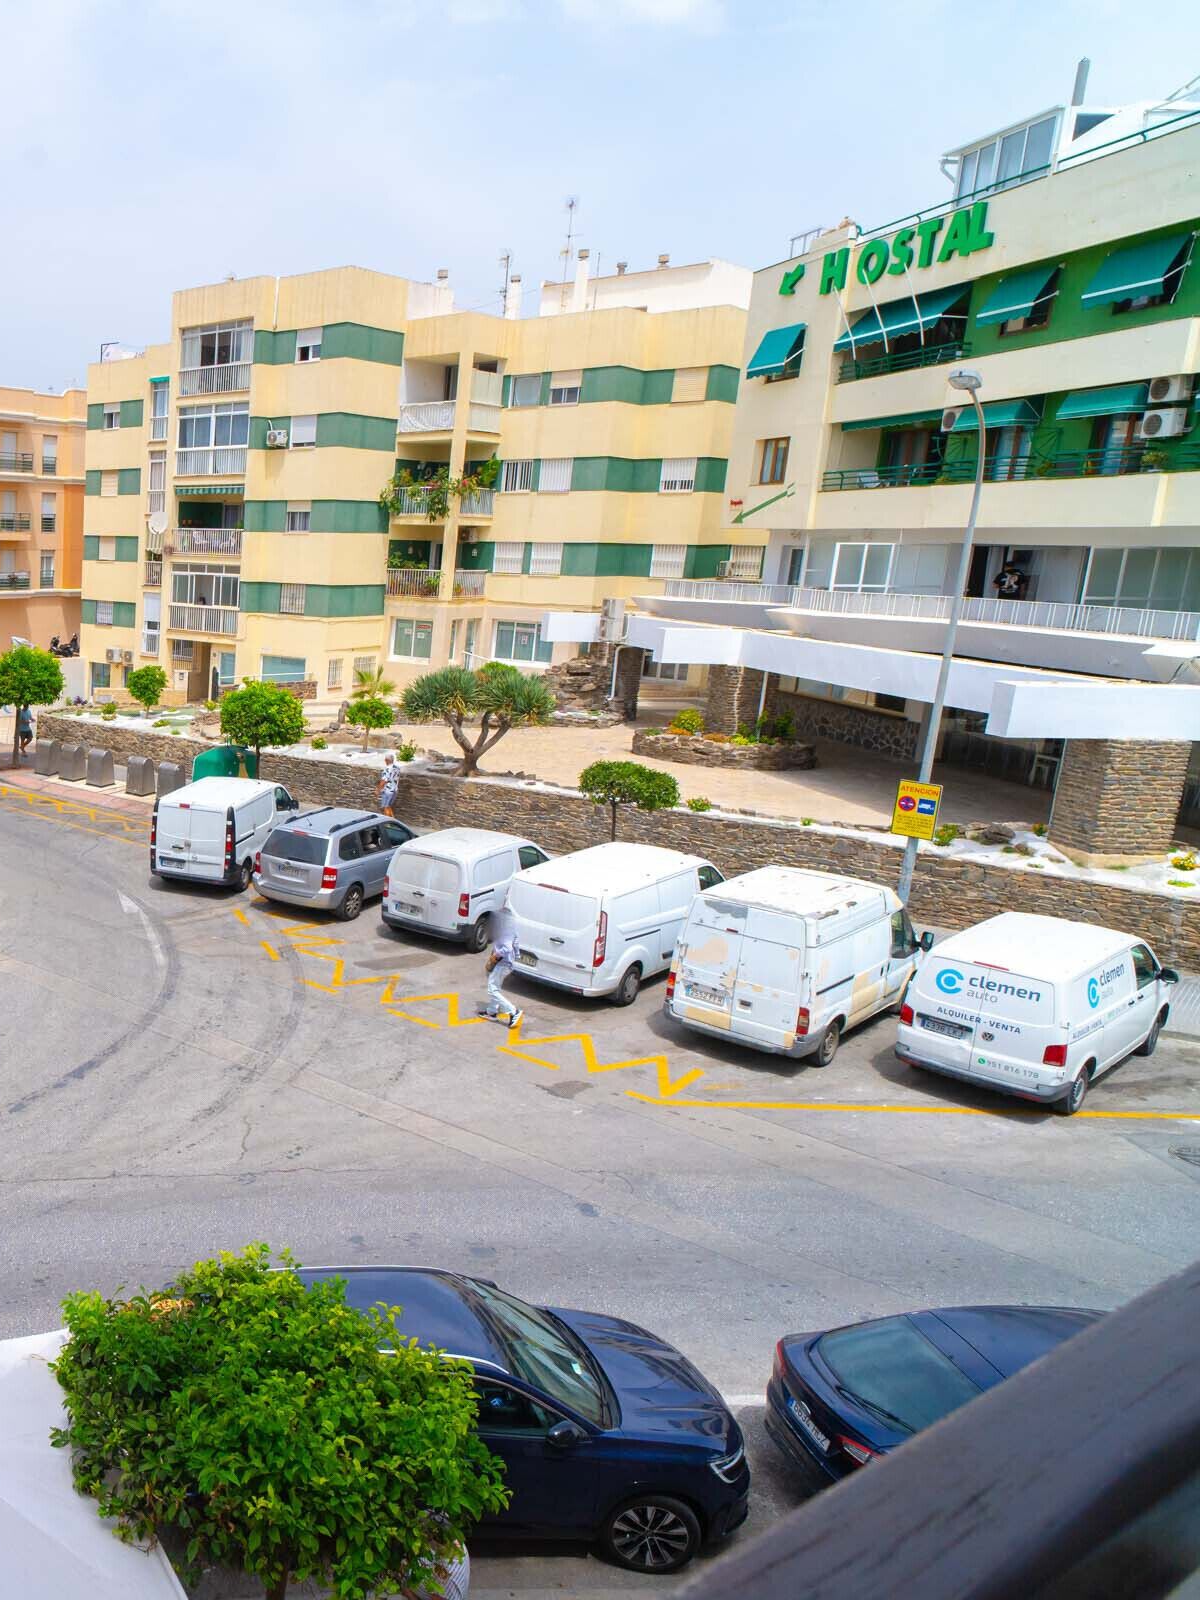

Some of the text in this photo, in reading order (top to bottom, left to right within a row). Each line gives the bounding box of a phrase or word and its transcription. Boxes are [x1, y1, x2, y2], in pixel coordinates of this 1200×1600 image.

[819, 201, 994, 295] HOSTAL
[1099, 963, 1125, 986] clemen
[966, 989, 998, 1003] auto
[969, 976, 1040, 1002] clemen
[937, 1006, 982, 1024] ALQUILER
[989, 1020, 1021, 1034] VENTA
